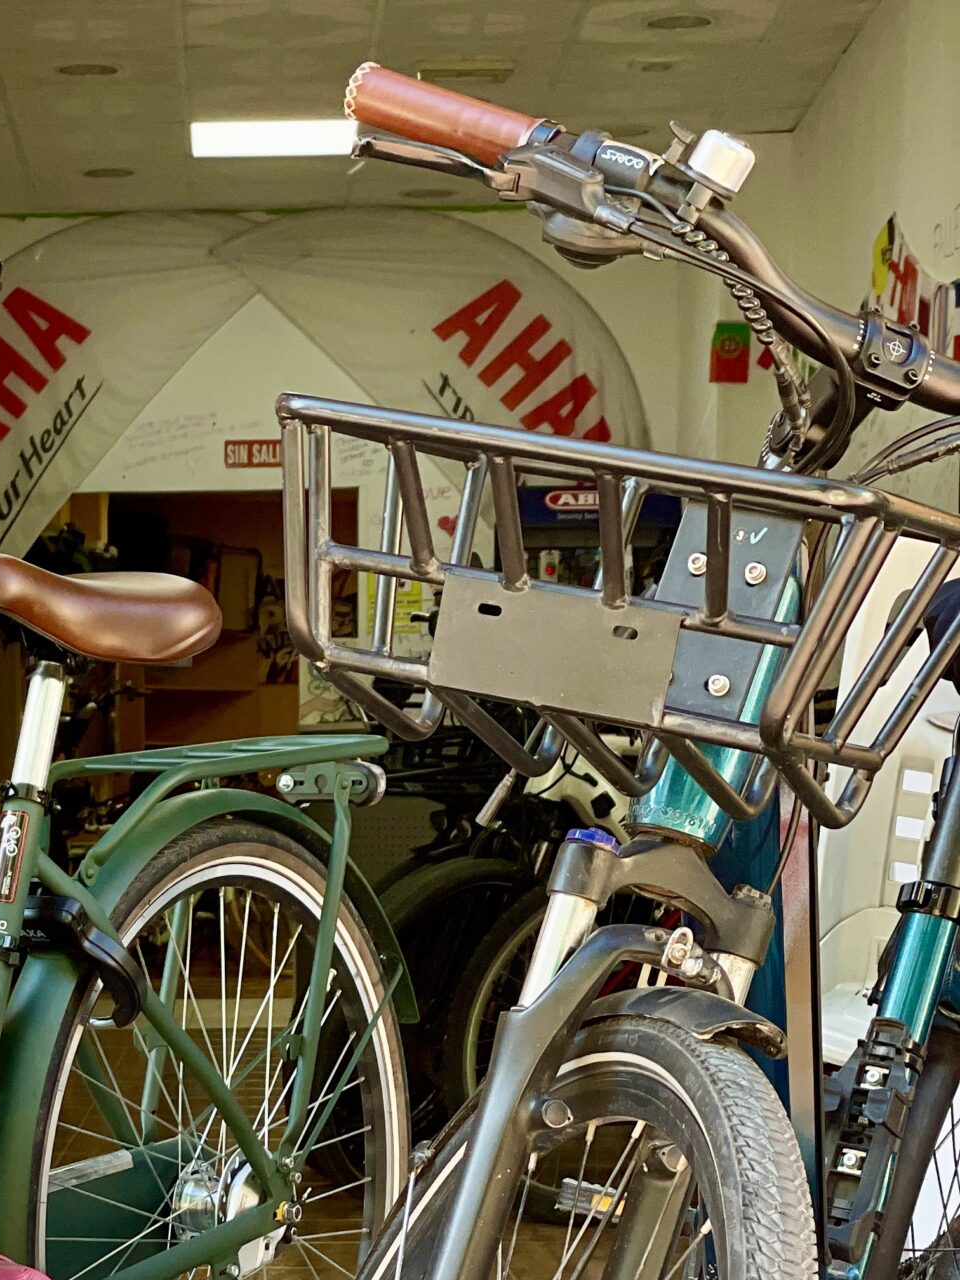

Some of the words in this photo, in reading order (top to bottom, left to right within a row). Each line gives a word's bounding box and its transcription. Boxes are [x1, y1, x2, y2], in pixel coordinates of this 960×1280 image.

[19, 373, 89, 481] Heart
[226, 443, 249, 465] SIN
[252, 442, 282, 464] SALI
